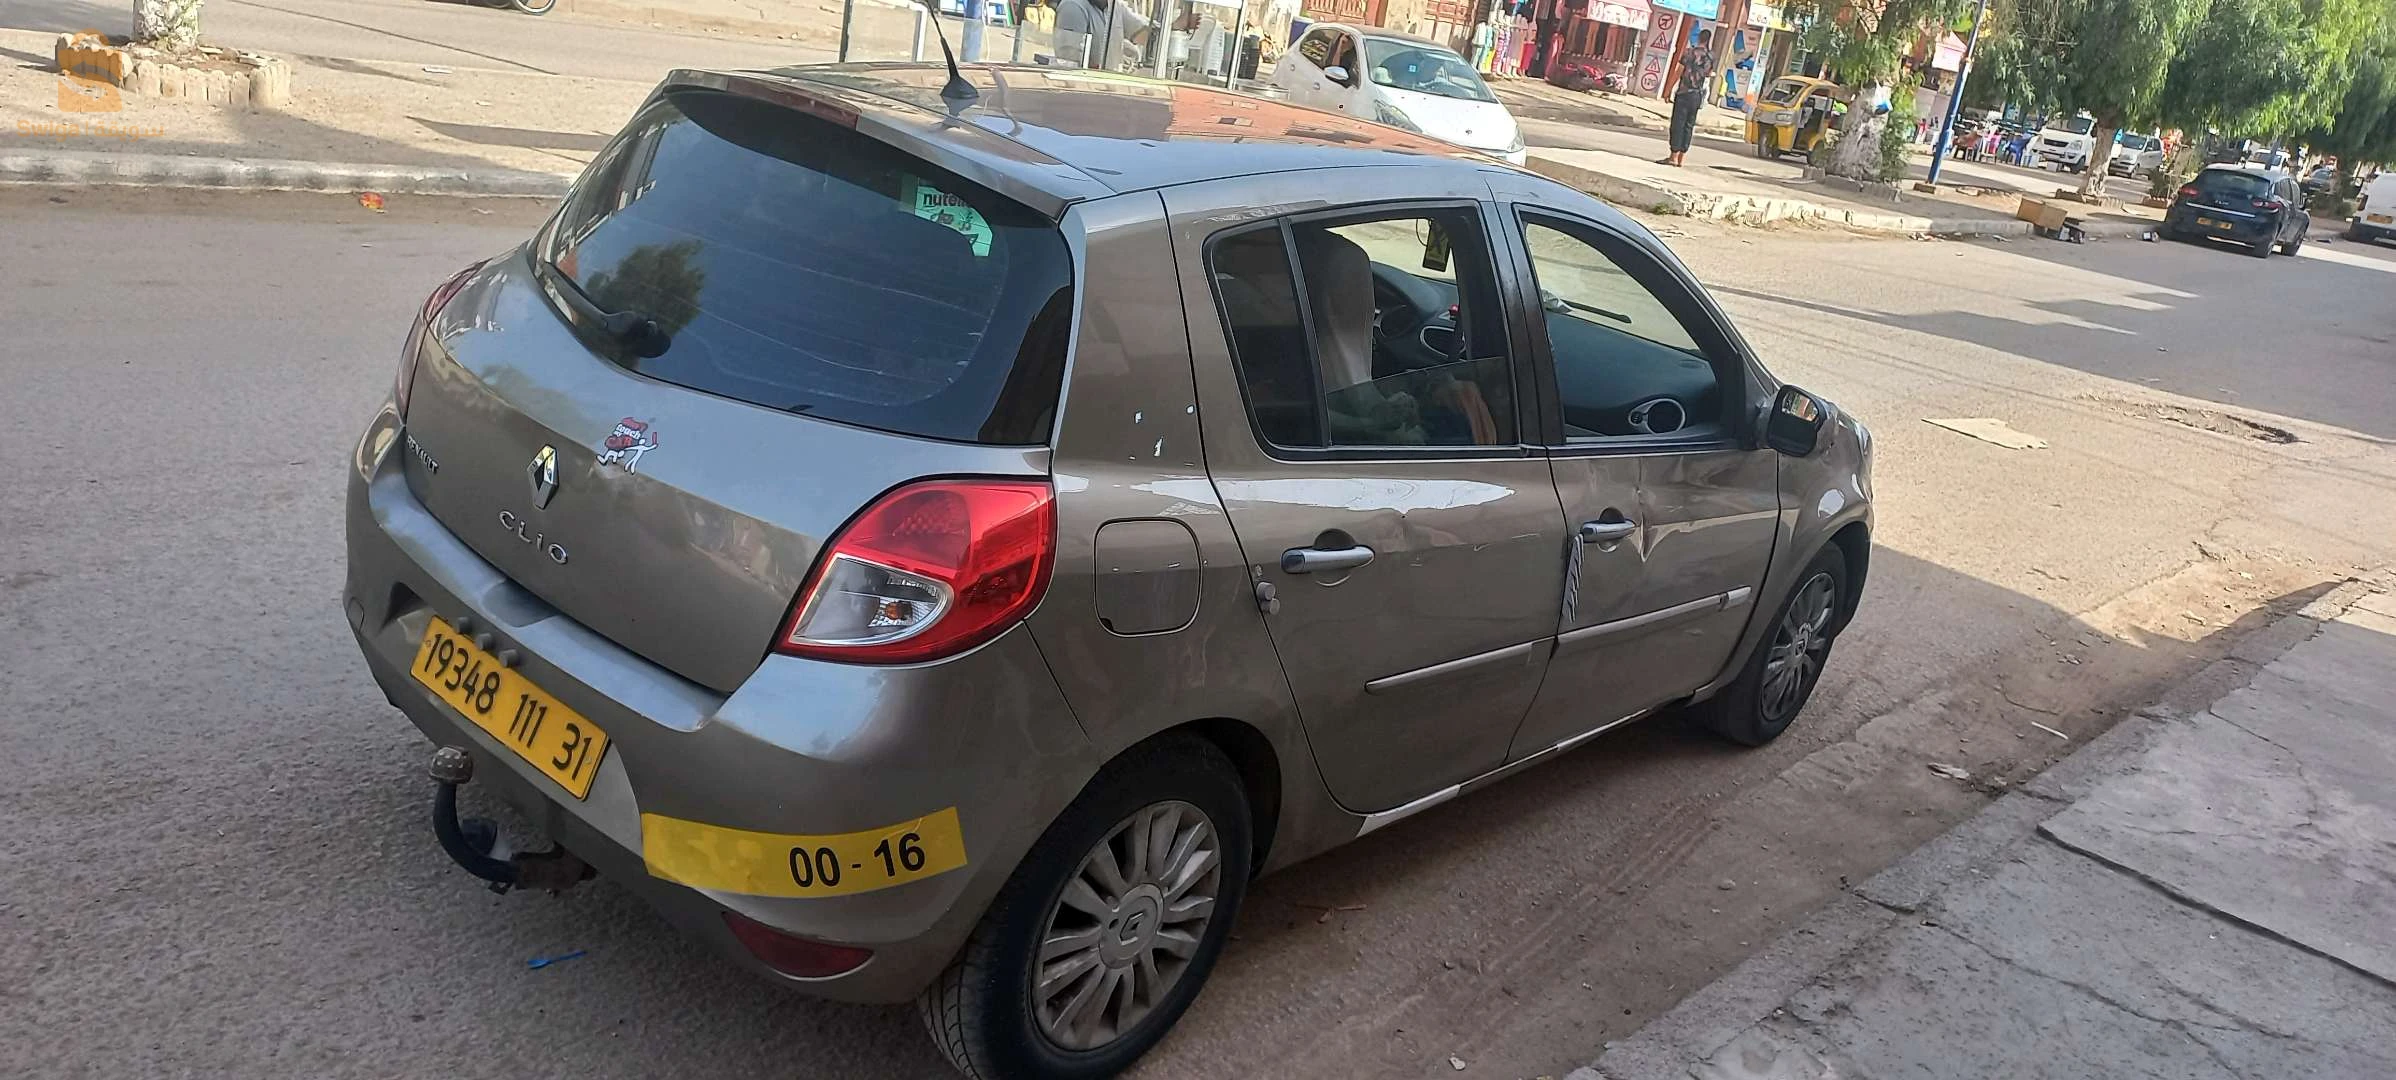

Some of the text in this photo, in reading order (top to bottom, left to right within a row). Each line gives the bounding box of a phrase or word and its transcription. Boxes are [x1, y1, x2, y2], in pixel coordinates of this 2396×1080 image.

[499, 510, 567, 564] CLIO
[424, 633, 592, 781] 19348 111 31
[789, 847, 841, 888] 00
[873, 832, 926, 877] 16
